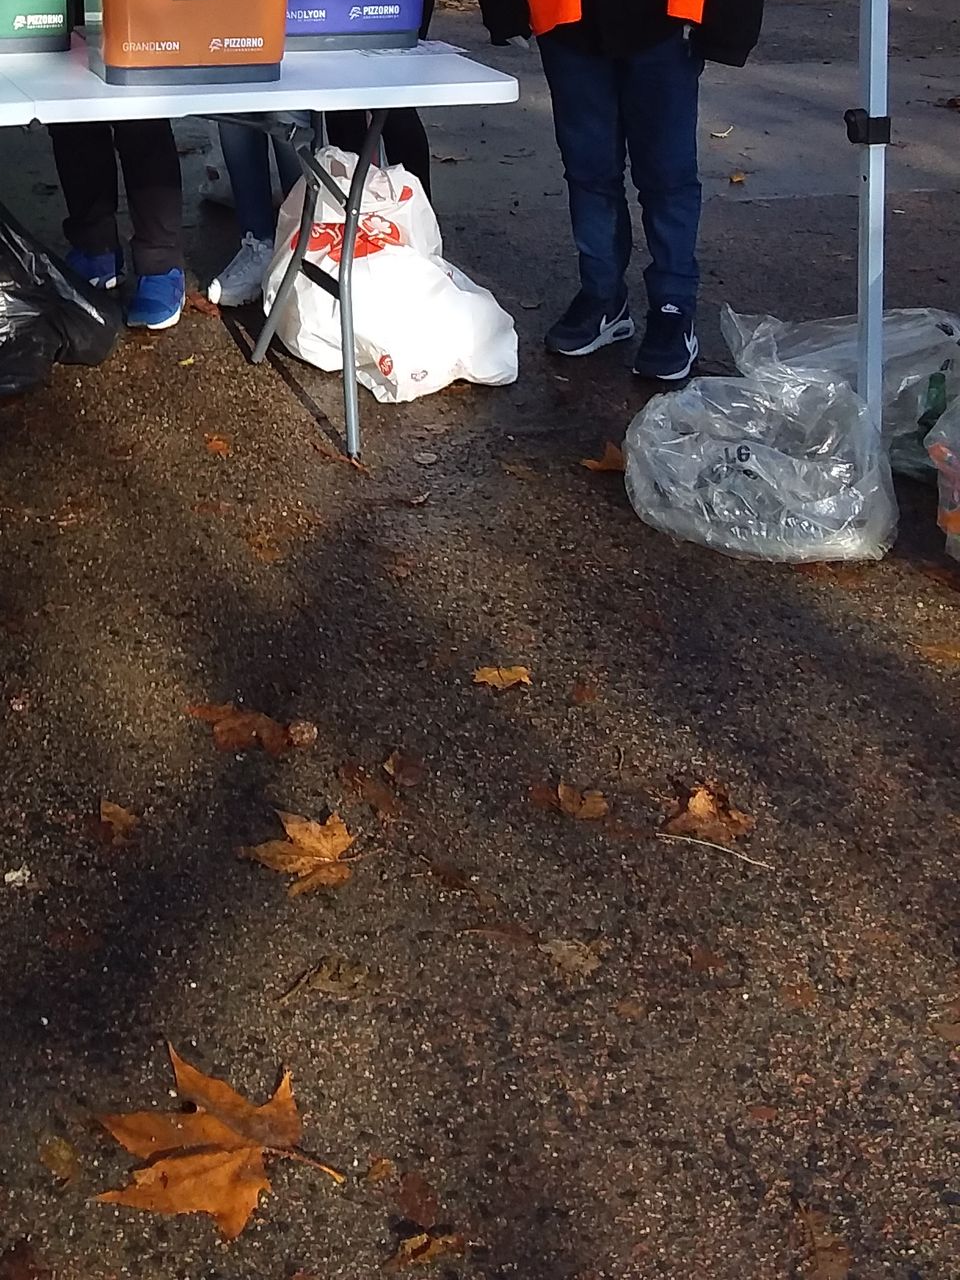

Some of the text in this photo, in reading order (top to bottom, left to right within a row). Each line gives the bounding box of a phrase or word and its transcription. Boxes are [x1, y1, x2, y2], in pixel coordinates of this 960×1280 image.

[286, 9, 326, 19] ANDLYON
[363, 5, 400, 15] PIZZORNO
[27, 14, 64, 25] PIZZORNO
[122, 41, 180, 52] GRANDLYON
[224, 37, 263, 48] PIZZORNO
